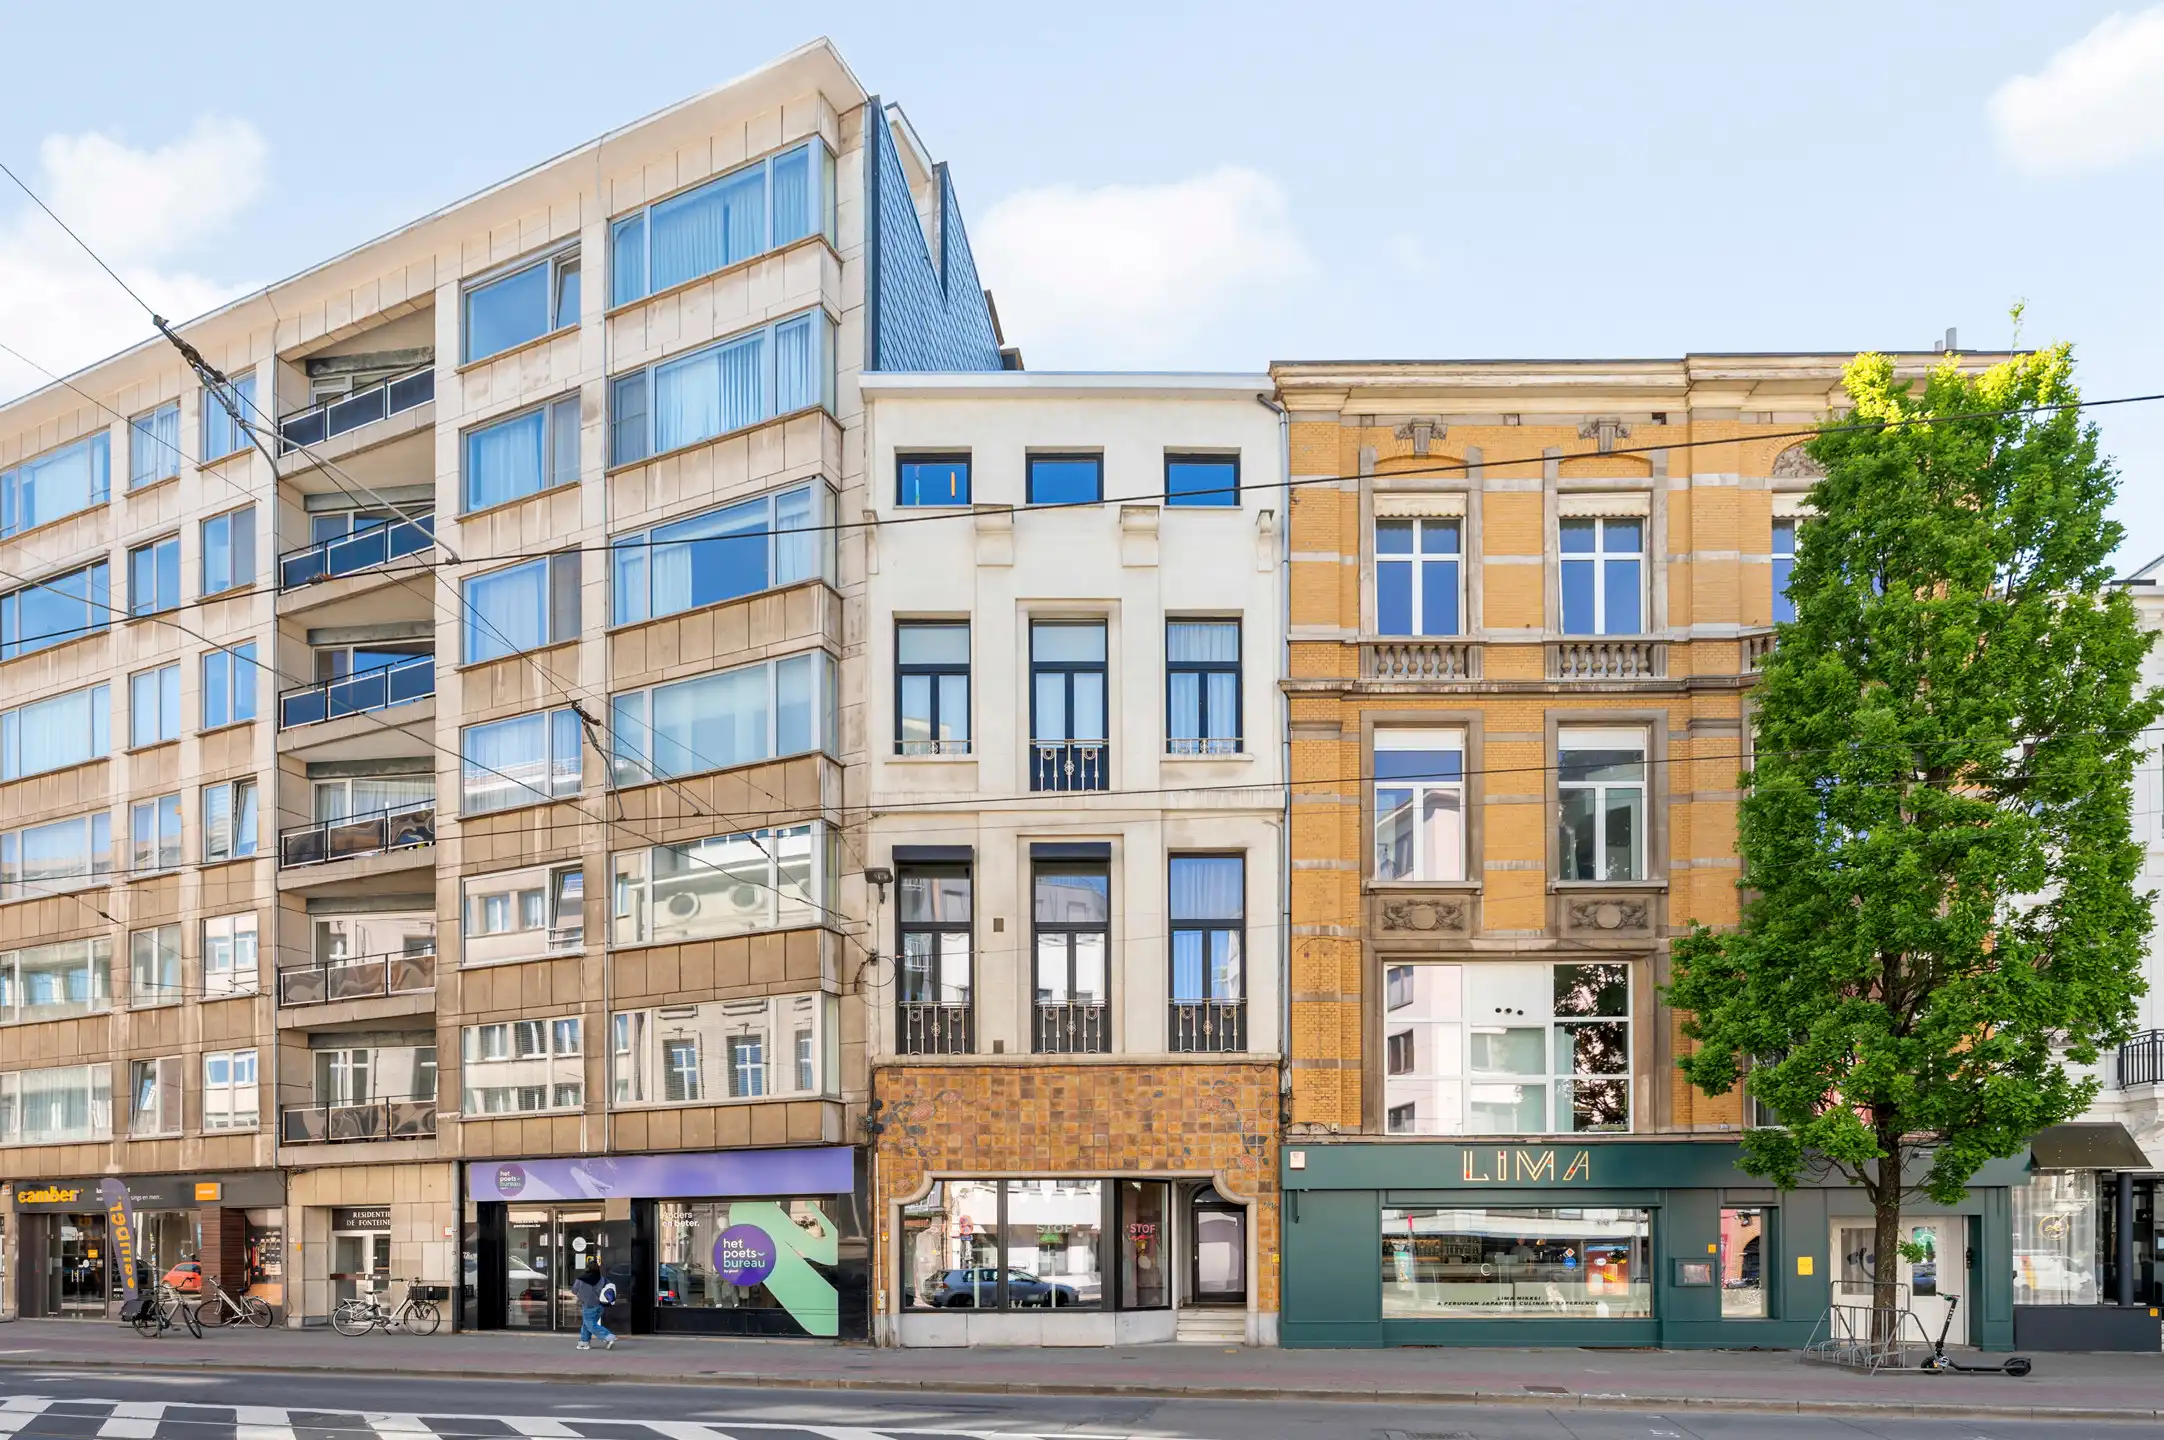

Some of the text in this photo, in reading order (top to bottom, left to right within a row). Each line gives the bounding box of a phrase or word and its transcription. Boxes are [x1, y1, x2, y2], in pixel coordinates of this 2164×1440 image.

[1463, 1150, 1589, 1181] LIMA
[662, 1211, 693, 1219] Anders
[1036, 1223, 1073, 1233] STOF
[1130, 1223, 1156, 1233] STOF
[723, 1238, 743, 1248] het
[723, 1248, 757, 1260] poets
[723, 1259, 766, 1268] bureau
